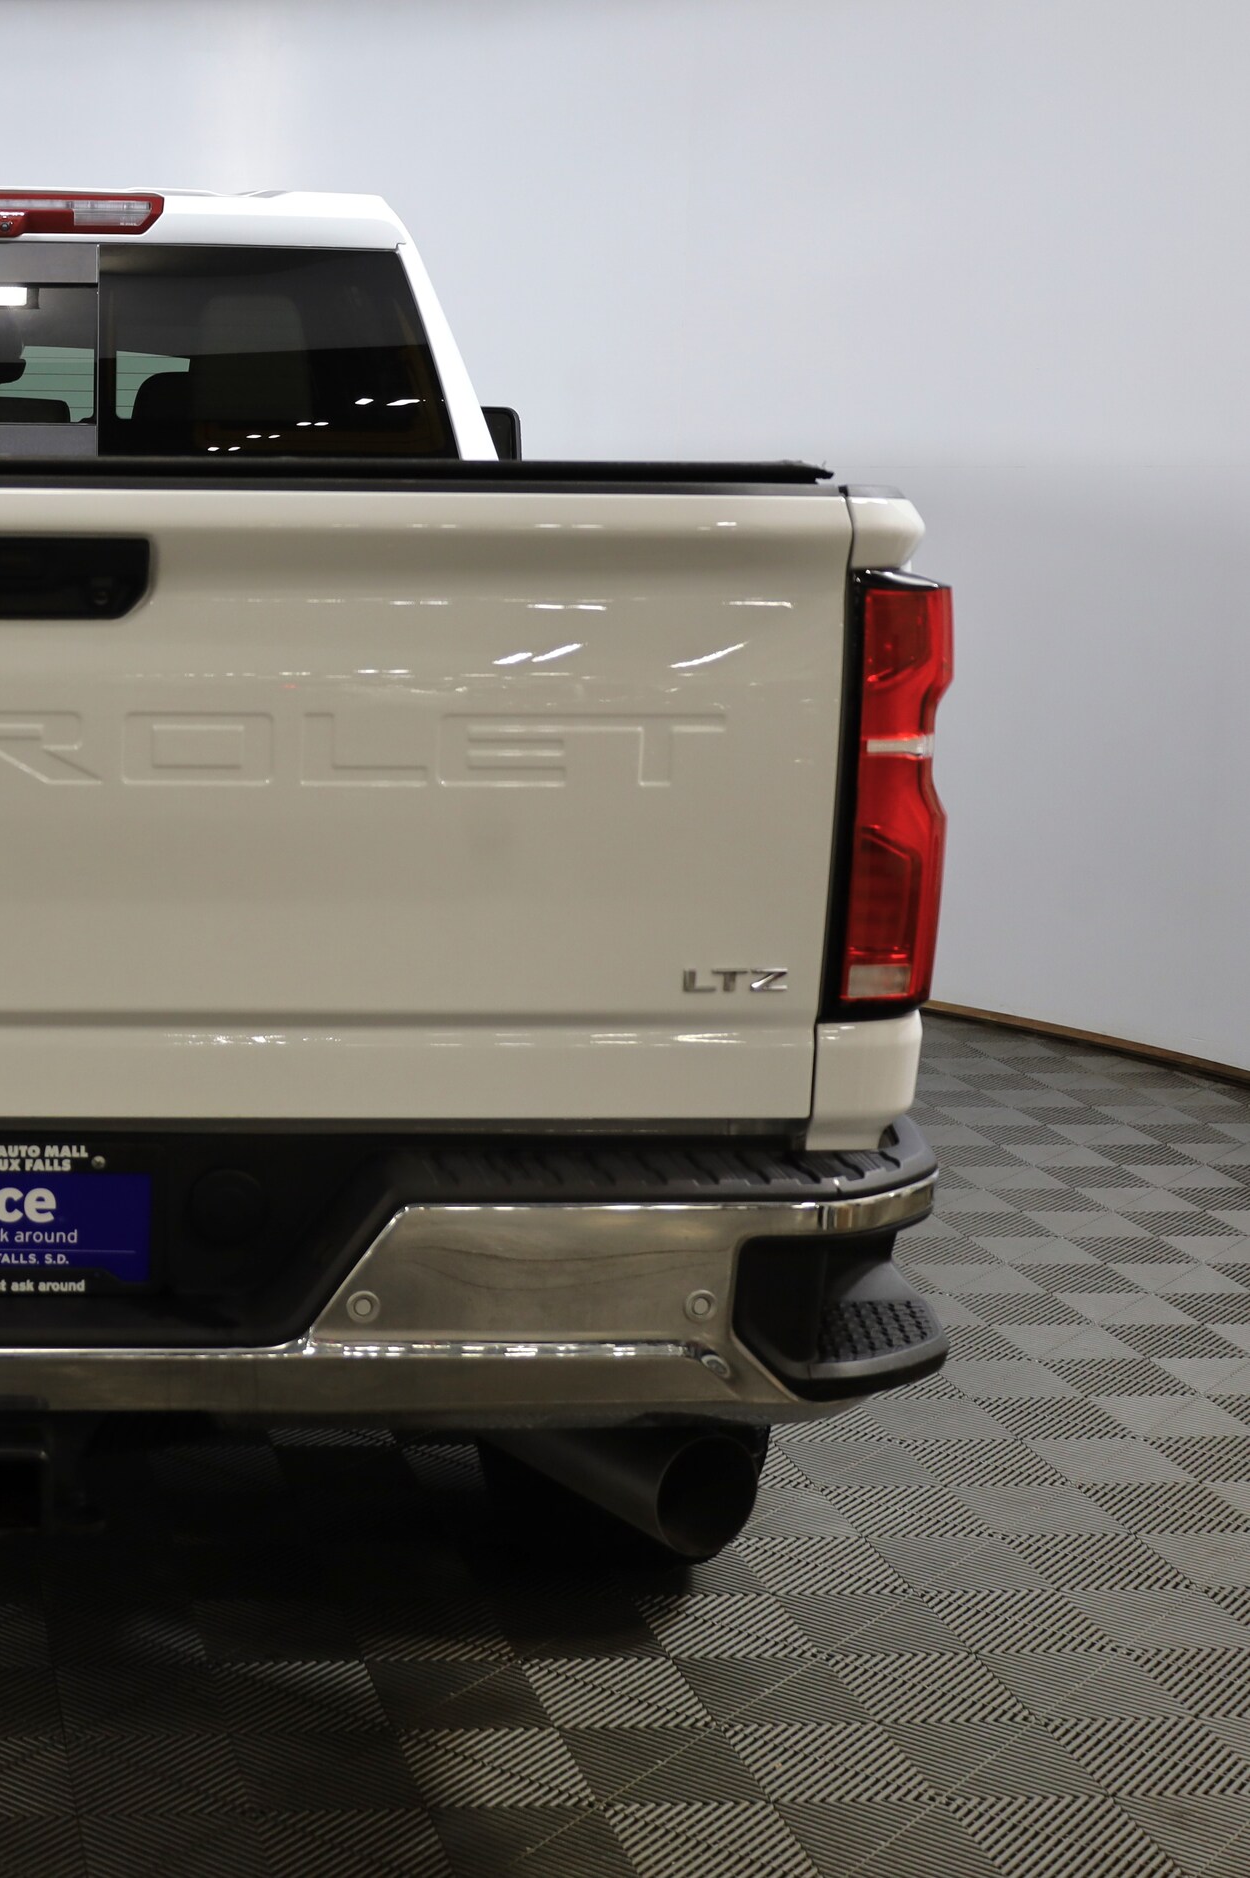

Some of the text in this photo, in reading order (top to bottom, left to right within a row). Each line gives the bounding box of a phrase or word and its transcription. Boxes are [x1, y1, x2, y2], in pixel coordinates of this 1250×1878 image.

[682, 967, 789, 992] LTZ
[44, 1145, 89, 1158] MALL
[24, 1158, 72, 1172] FALLS
[14, 1229, 78, 1243] around
[44, 1253, 70, 1265] S.D.
[10, 1280, 34, 1292] ask
[38, 1280, 86, 1292] around
